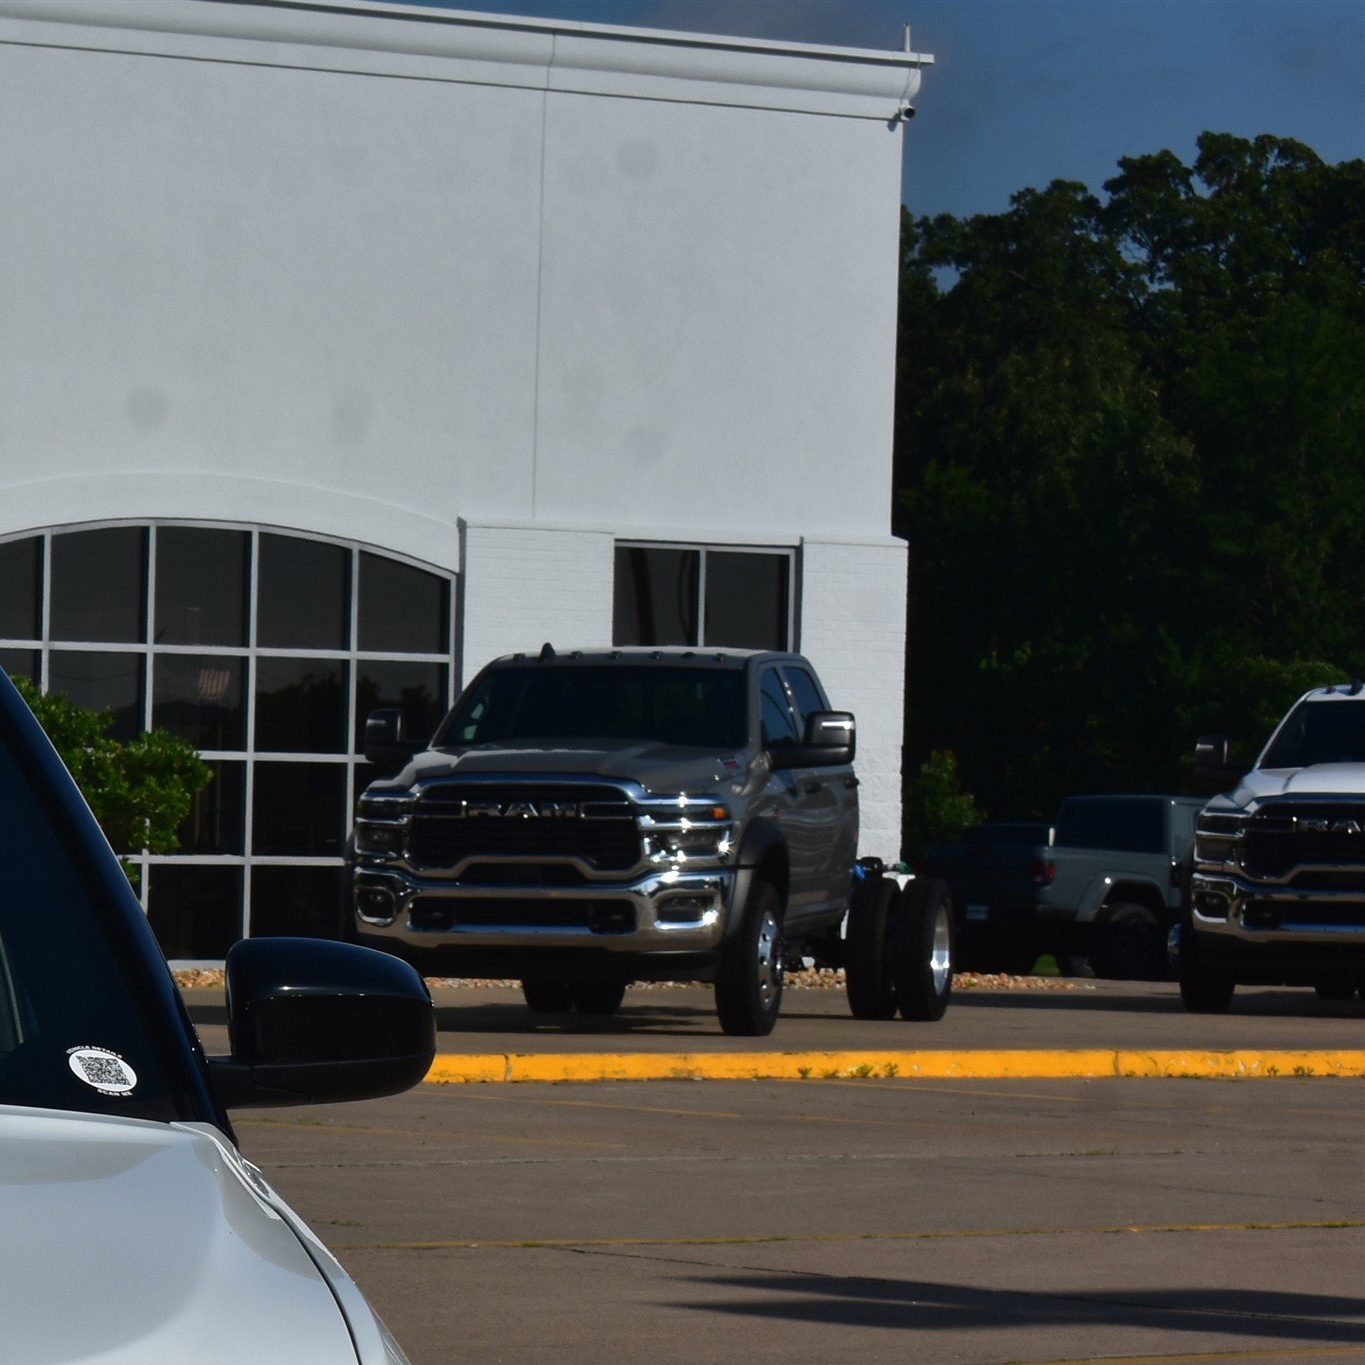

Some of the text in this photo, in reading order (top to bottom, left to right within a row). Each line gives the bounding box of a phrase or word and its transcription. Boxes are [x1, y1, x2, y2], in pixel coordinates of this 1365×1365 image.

[468, 802, 577, 818] RAM
[1299, 818, 1365, 833] RA
[91, 1045, 123, 1059] DETAILS
[97, 1088, 120, 1097] SCAN
